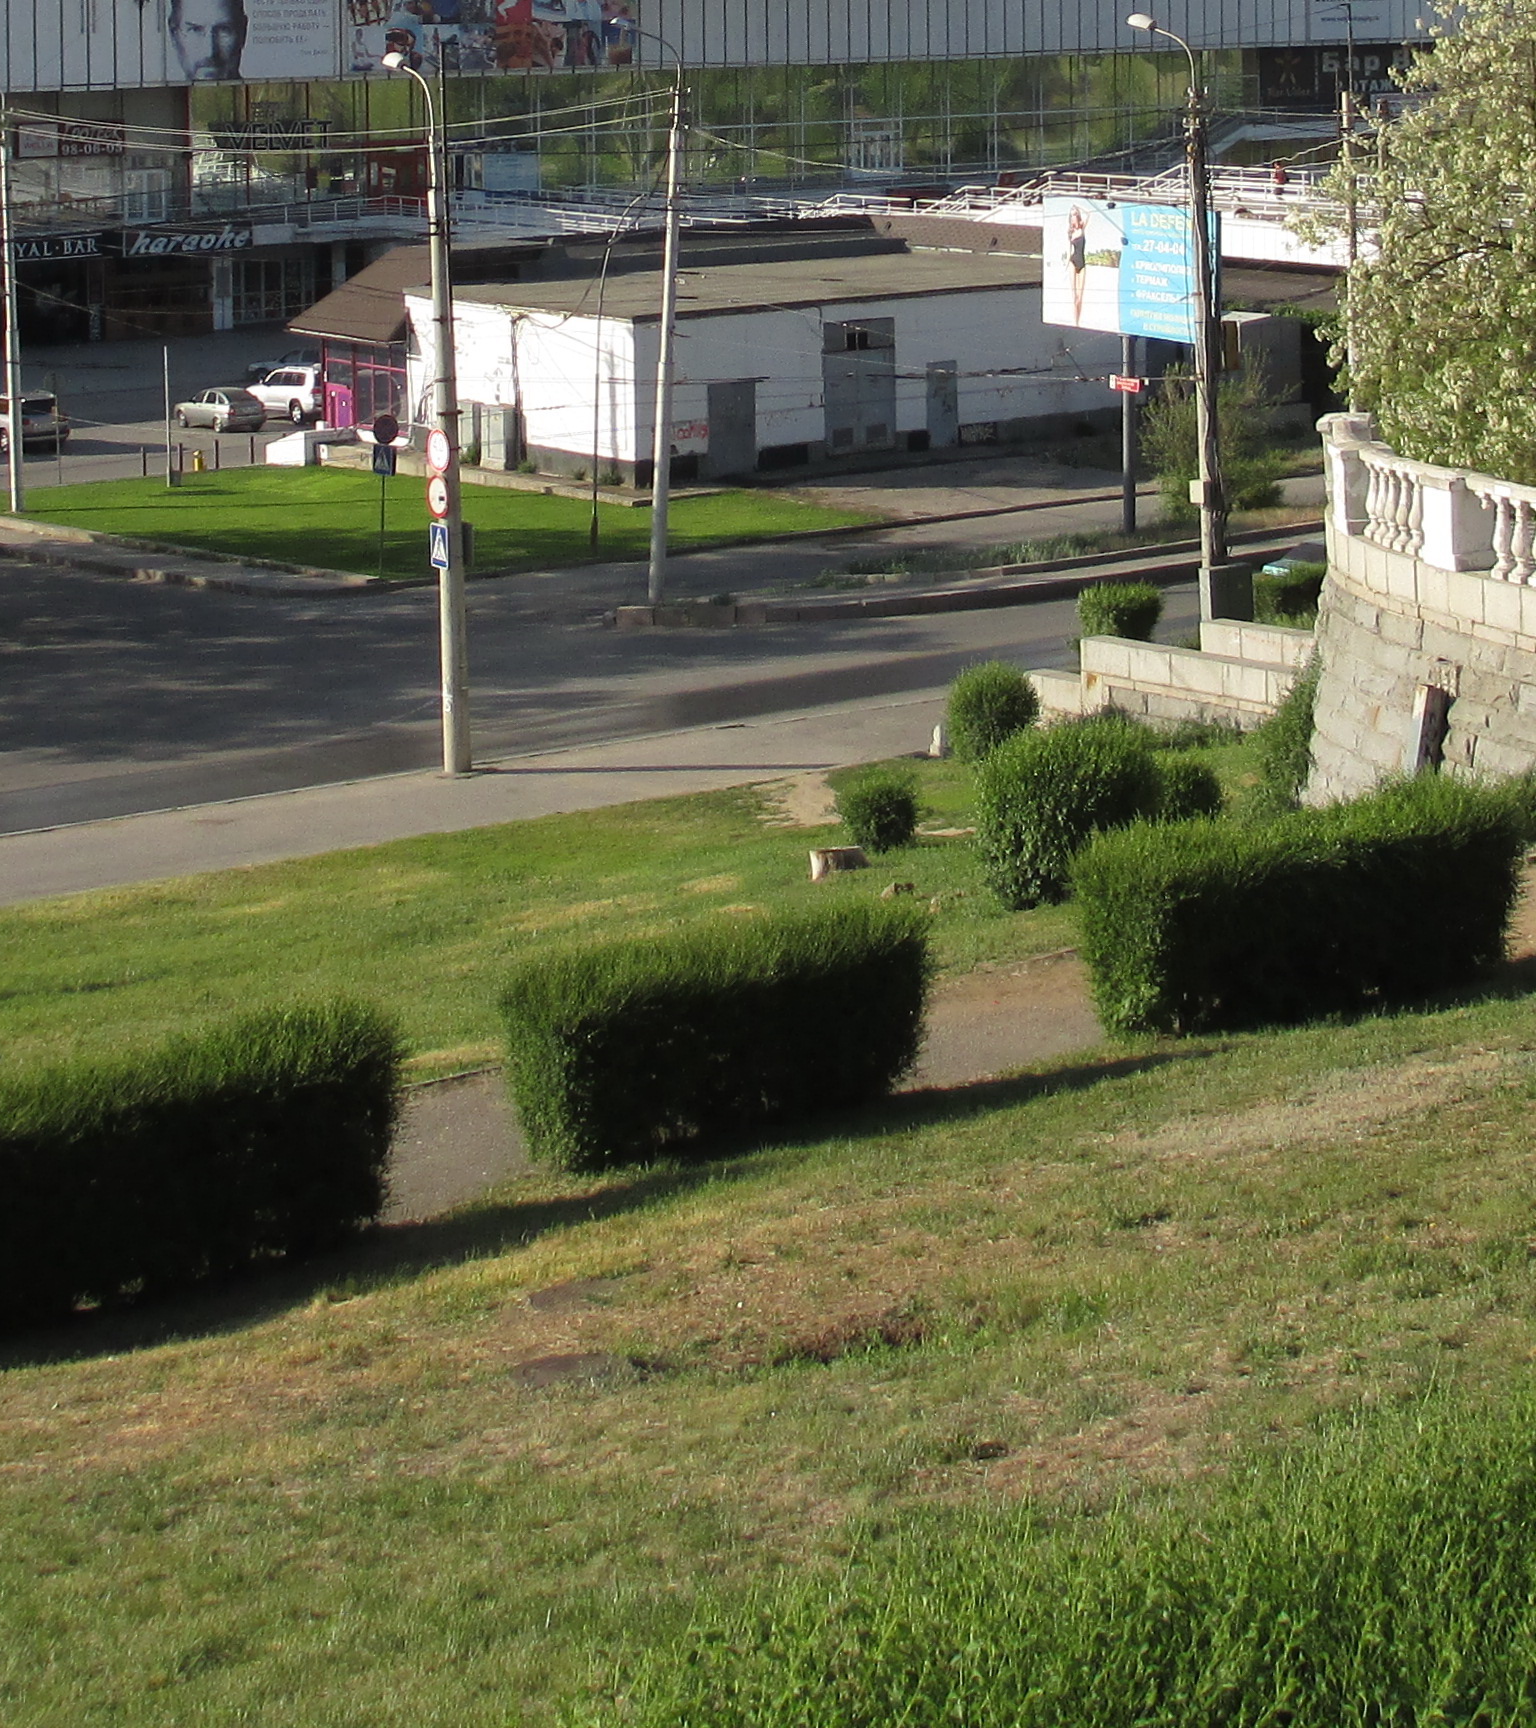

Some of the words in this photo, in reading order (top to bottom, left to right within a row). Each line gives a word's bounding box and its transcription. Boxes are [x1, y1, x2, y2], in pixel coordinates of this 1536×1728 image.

[225, 120, 333, 150] VELVET
[63, 238, 98, 255] BAR
[129, 224, 249, 255] karaoke
